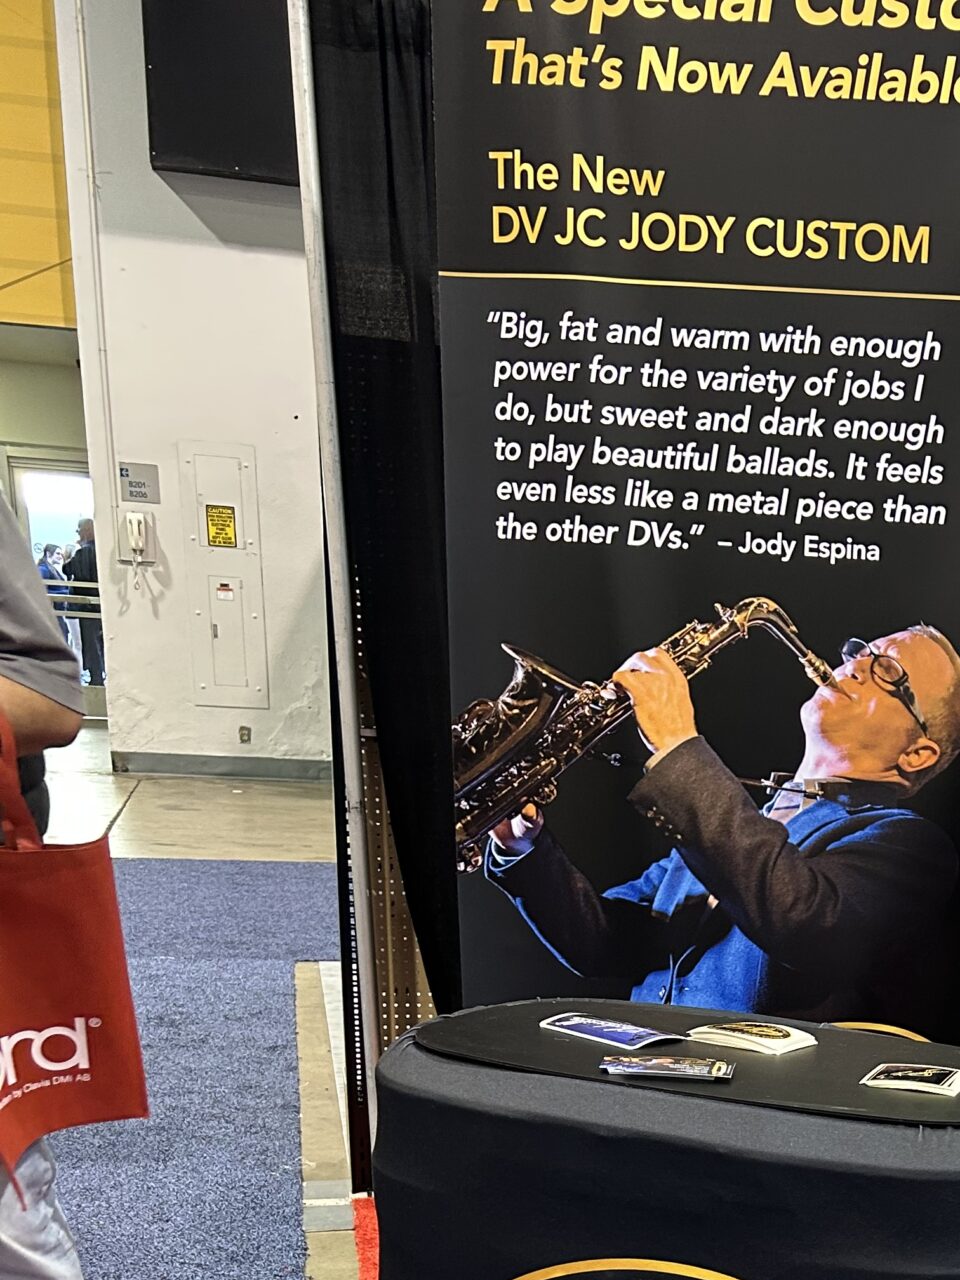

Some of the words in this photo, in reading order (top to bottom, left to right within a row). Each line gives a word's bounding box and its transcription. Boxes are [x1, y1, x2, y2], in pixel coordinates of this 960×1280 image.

[486, 38, 622, 89] That’s
[637, 46, 753, 94] Now
[489, 149, 558, 191] The
[573, 154, 665, 196] New
[493, 206, 546, 243] DV
[555, 208, 606, 247] JC
[619, 212, 735, 253] JODY
[746, 218, 929, 264] CUSTOM
[559, 311, 598, 342] fat
[606, 318, 662, 345] and
[671, 328, 749, 350] warm
[760, 325, 820, 355] with
[831, 330, 941, 367] enough
[494, 361, 580, 388] power
[589, 355, 632, 384] for
[641, 359, 687, 389] the
[697, 364, 796, 402] variety
[804, 366, 838, 396] of
[839, 371, 905, 405] jobs
[914, 374, 924, 401] I
[494, 393, 536, 425] do,
[546, 394, 592, 424] but
[600, 405, 687, 430] sweet
[696, 405, 751, 433] and
[760, 407, 825, 438] dark
[834, 415, 944, 451] enough
[494, 437, 521, 461] to
[529, 434, 585, 470] play
[593, 436, 718, 472] beautiful
[727, 445, 835, 479] ballads.
[846, 453, 867, 481] It
[876, 453, 944, 485] feels
[497, 482, 556, 502] even
[565, 475, 615, 505] less
[625, 479, 673, 510] like
[682, 491, 698, 511] a
[708, 488, 789, 516] metal
[796, 491, 873, 525] piece
[883, 495, 946, 525] than
[496, 512, 537, 541] the
[546, 515, 619, 545] other
[738, 532, 796, 562] Jody
[804, 535, 880, 565] Espina
